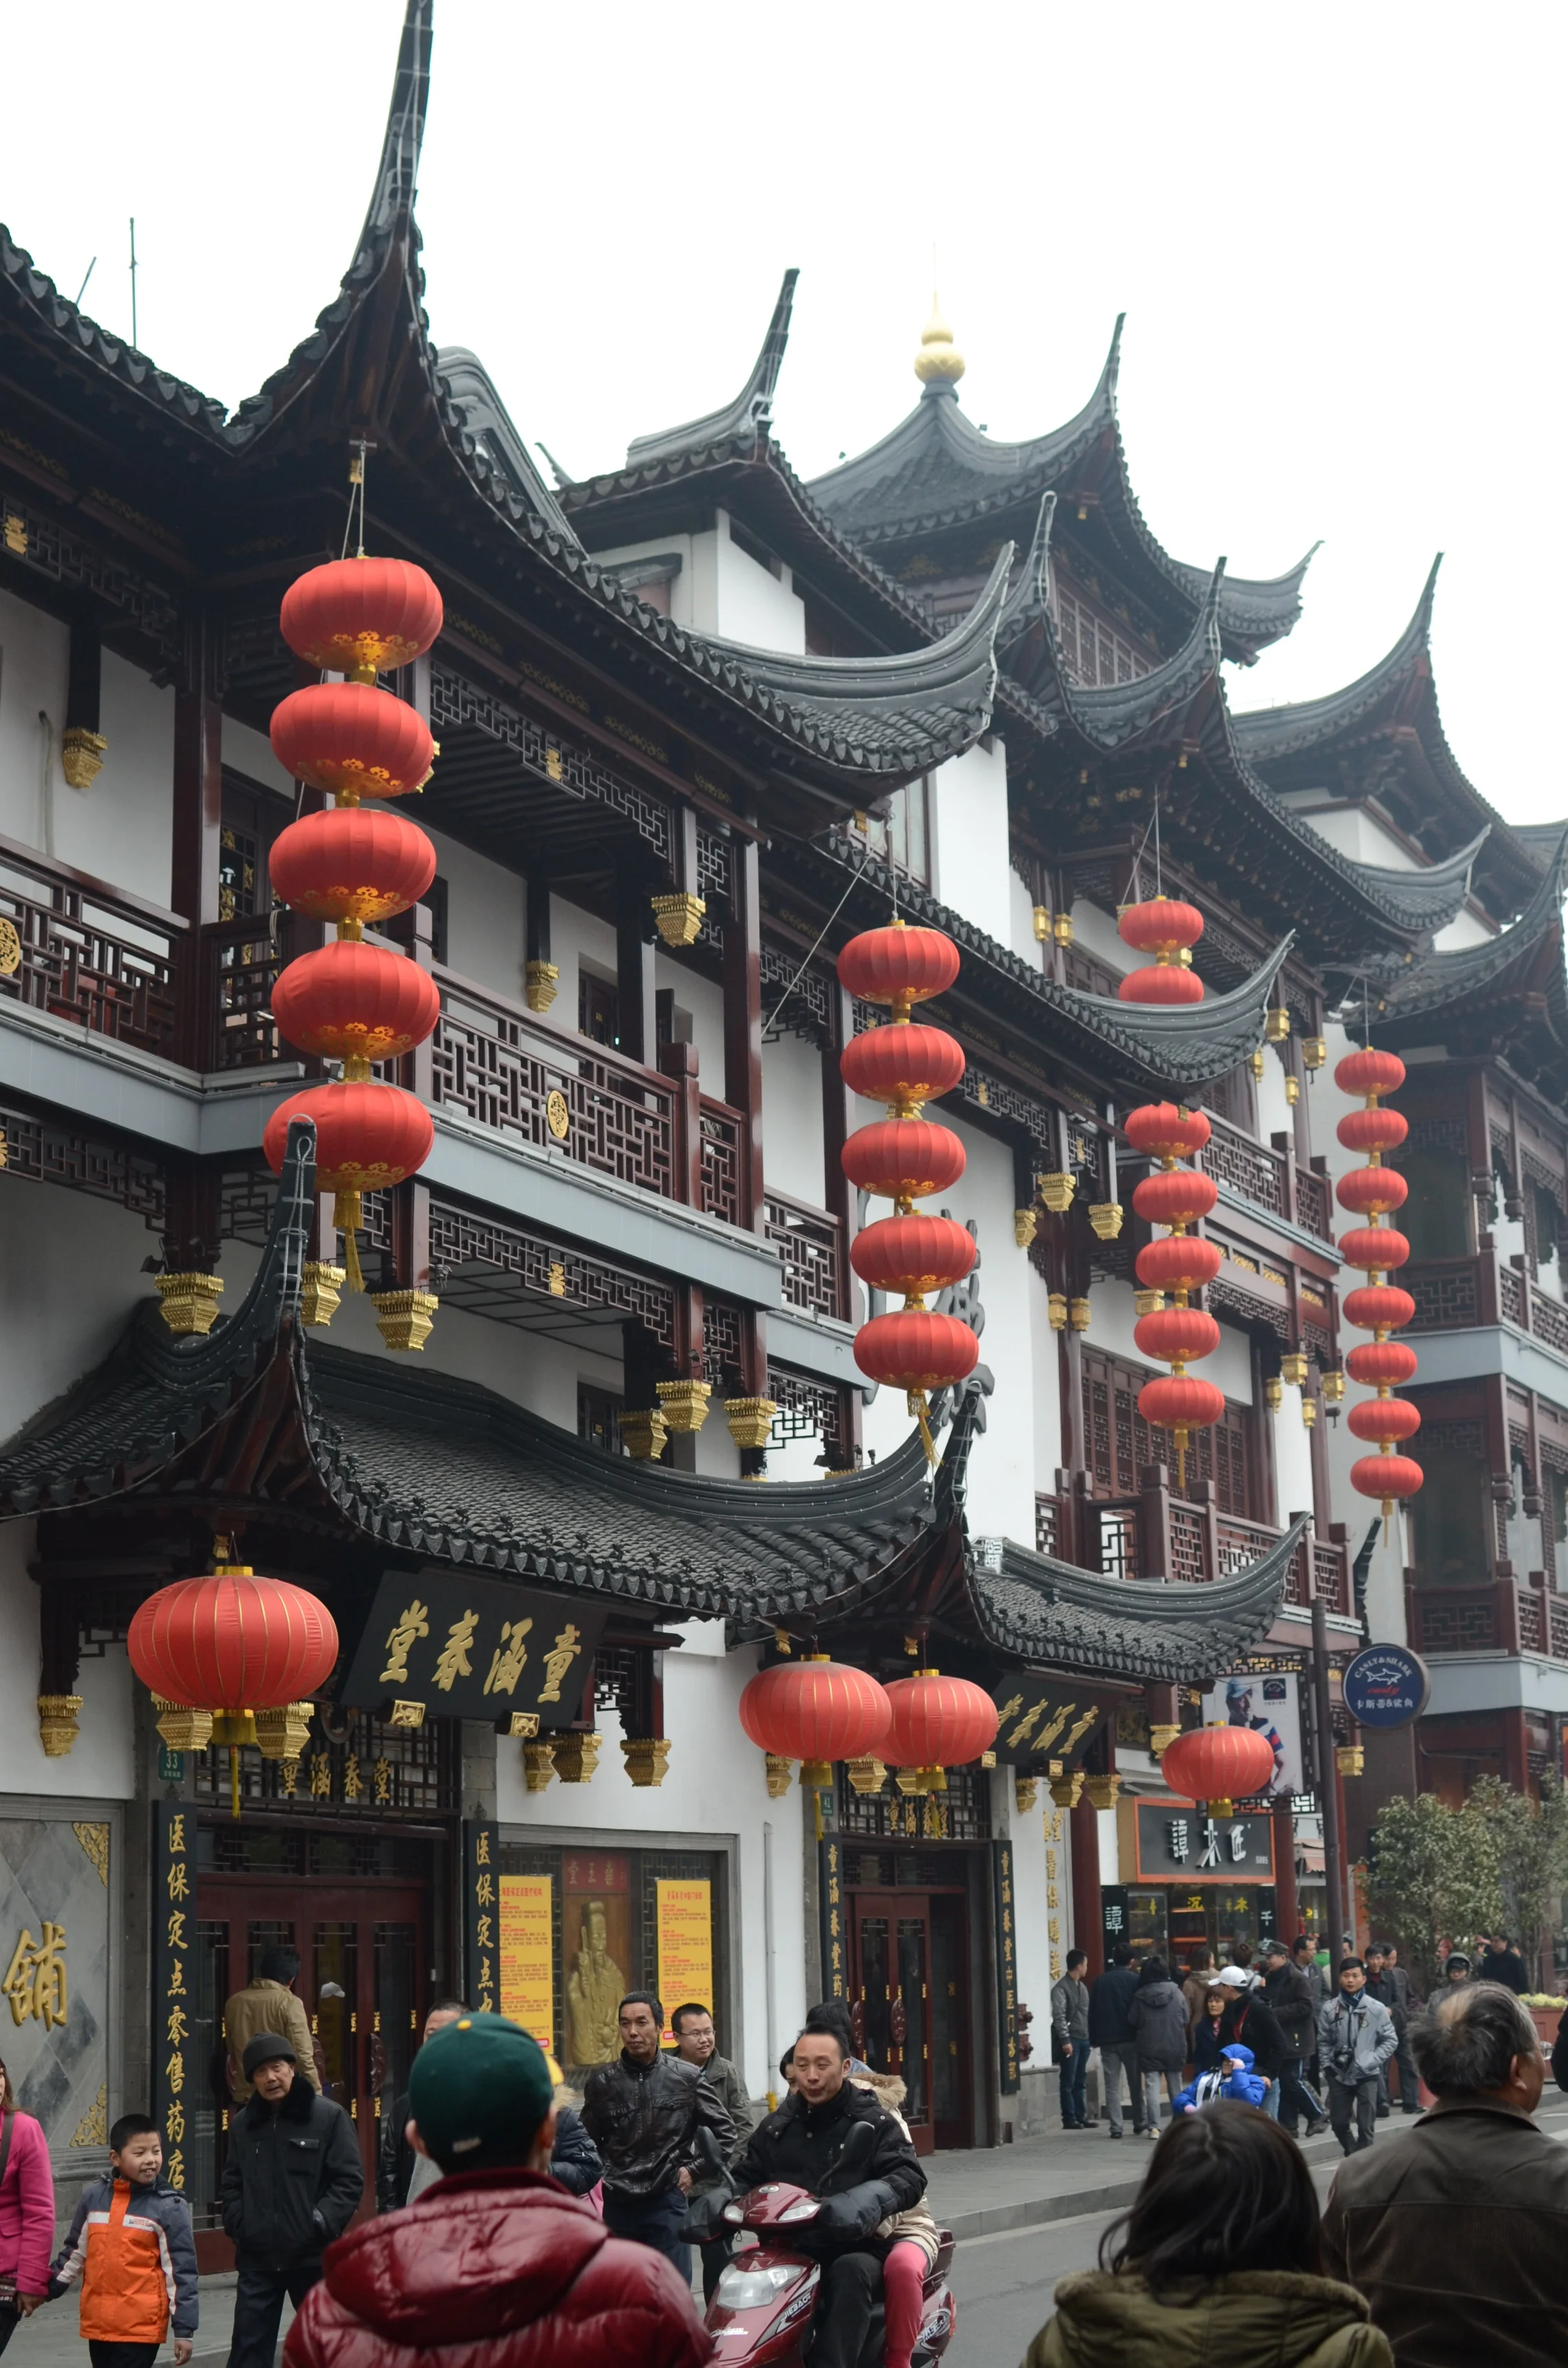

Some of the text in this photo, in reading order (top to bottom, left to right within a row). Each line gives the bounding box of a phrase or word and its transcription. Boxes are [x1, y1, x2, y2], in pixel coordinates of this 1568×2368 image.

[166, 1752, 178, 1769] 33
[166, 1814, 190, 2190] 医保定点零售药店
